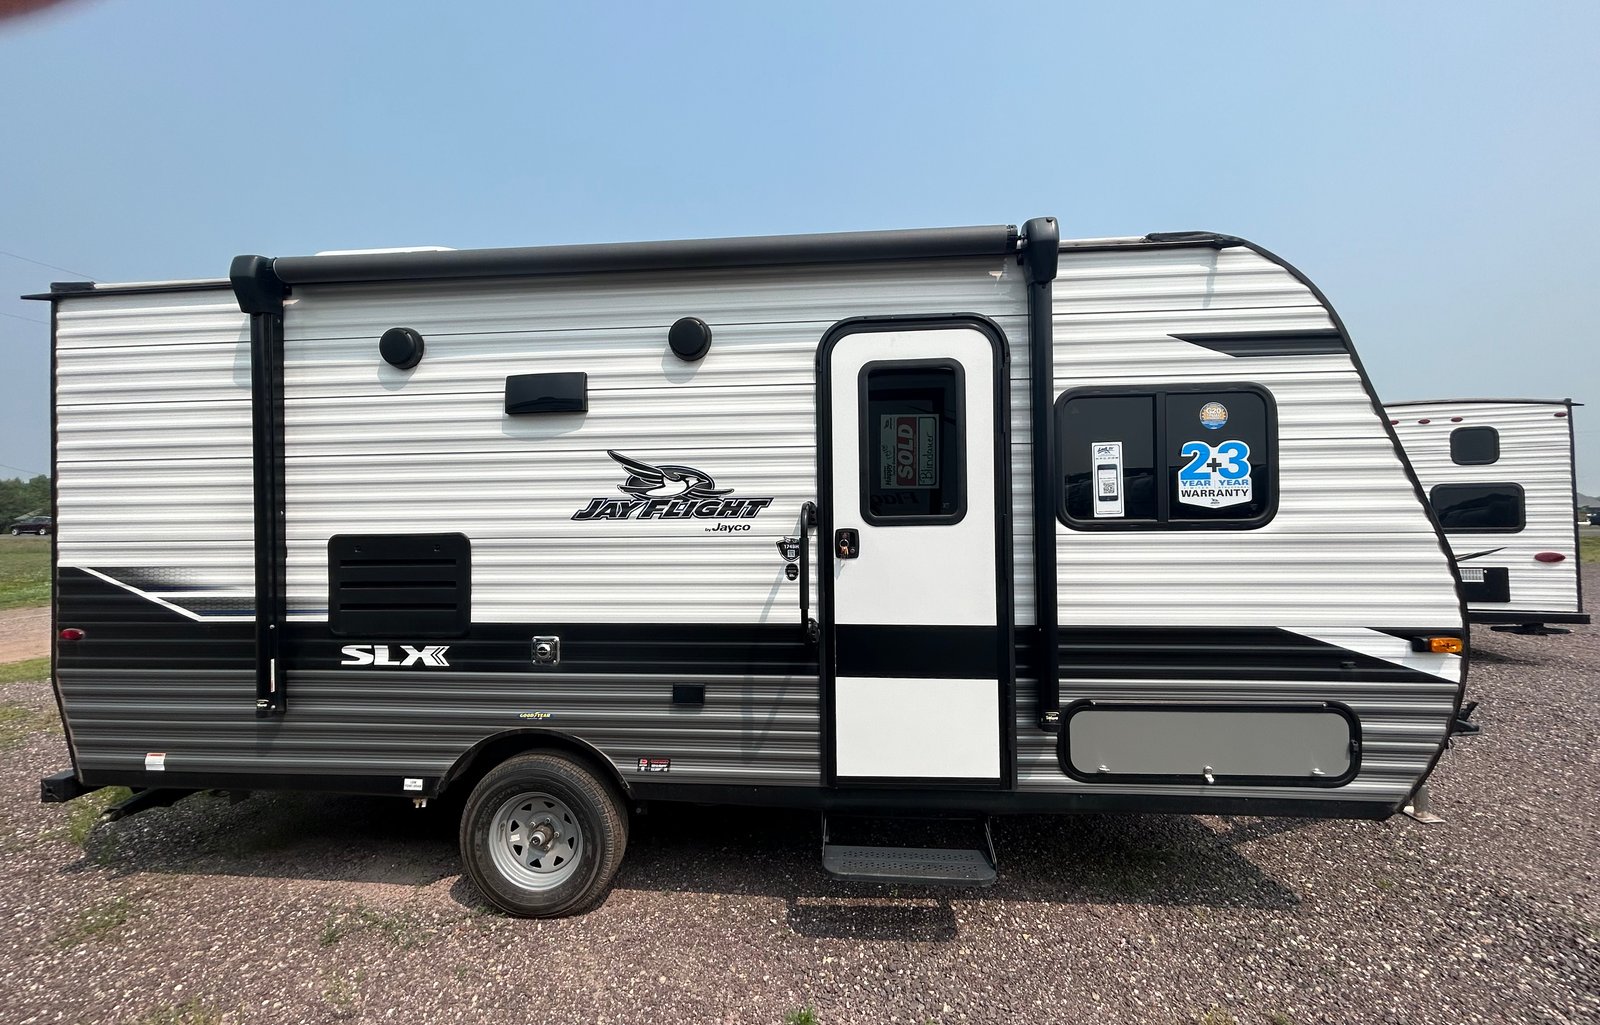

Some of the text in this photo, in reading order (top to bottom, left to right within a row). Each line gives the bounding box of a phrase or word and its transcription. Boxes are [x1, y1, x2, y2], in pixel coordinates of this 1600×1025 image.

[897, 424, 914, 480] SOLD
[1181, 478, 1249, 487] YEAR YEAR
[1181, 488, 1249, 498] WARRANTY
[571, 497, 774, 520] JAY FLIGHT
[711, 522, 751, 534] Jayco
[340, 644, 450, 668] SLX
